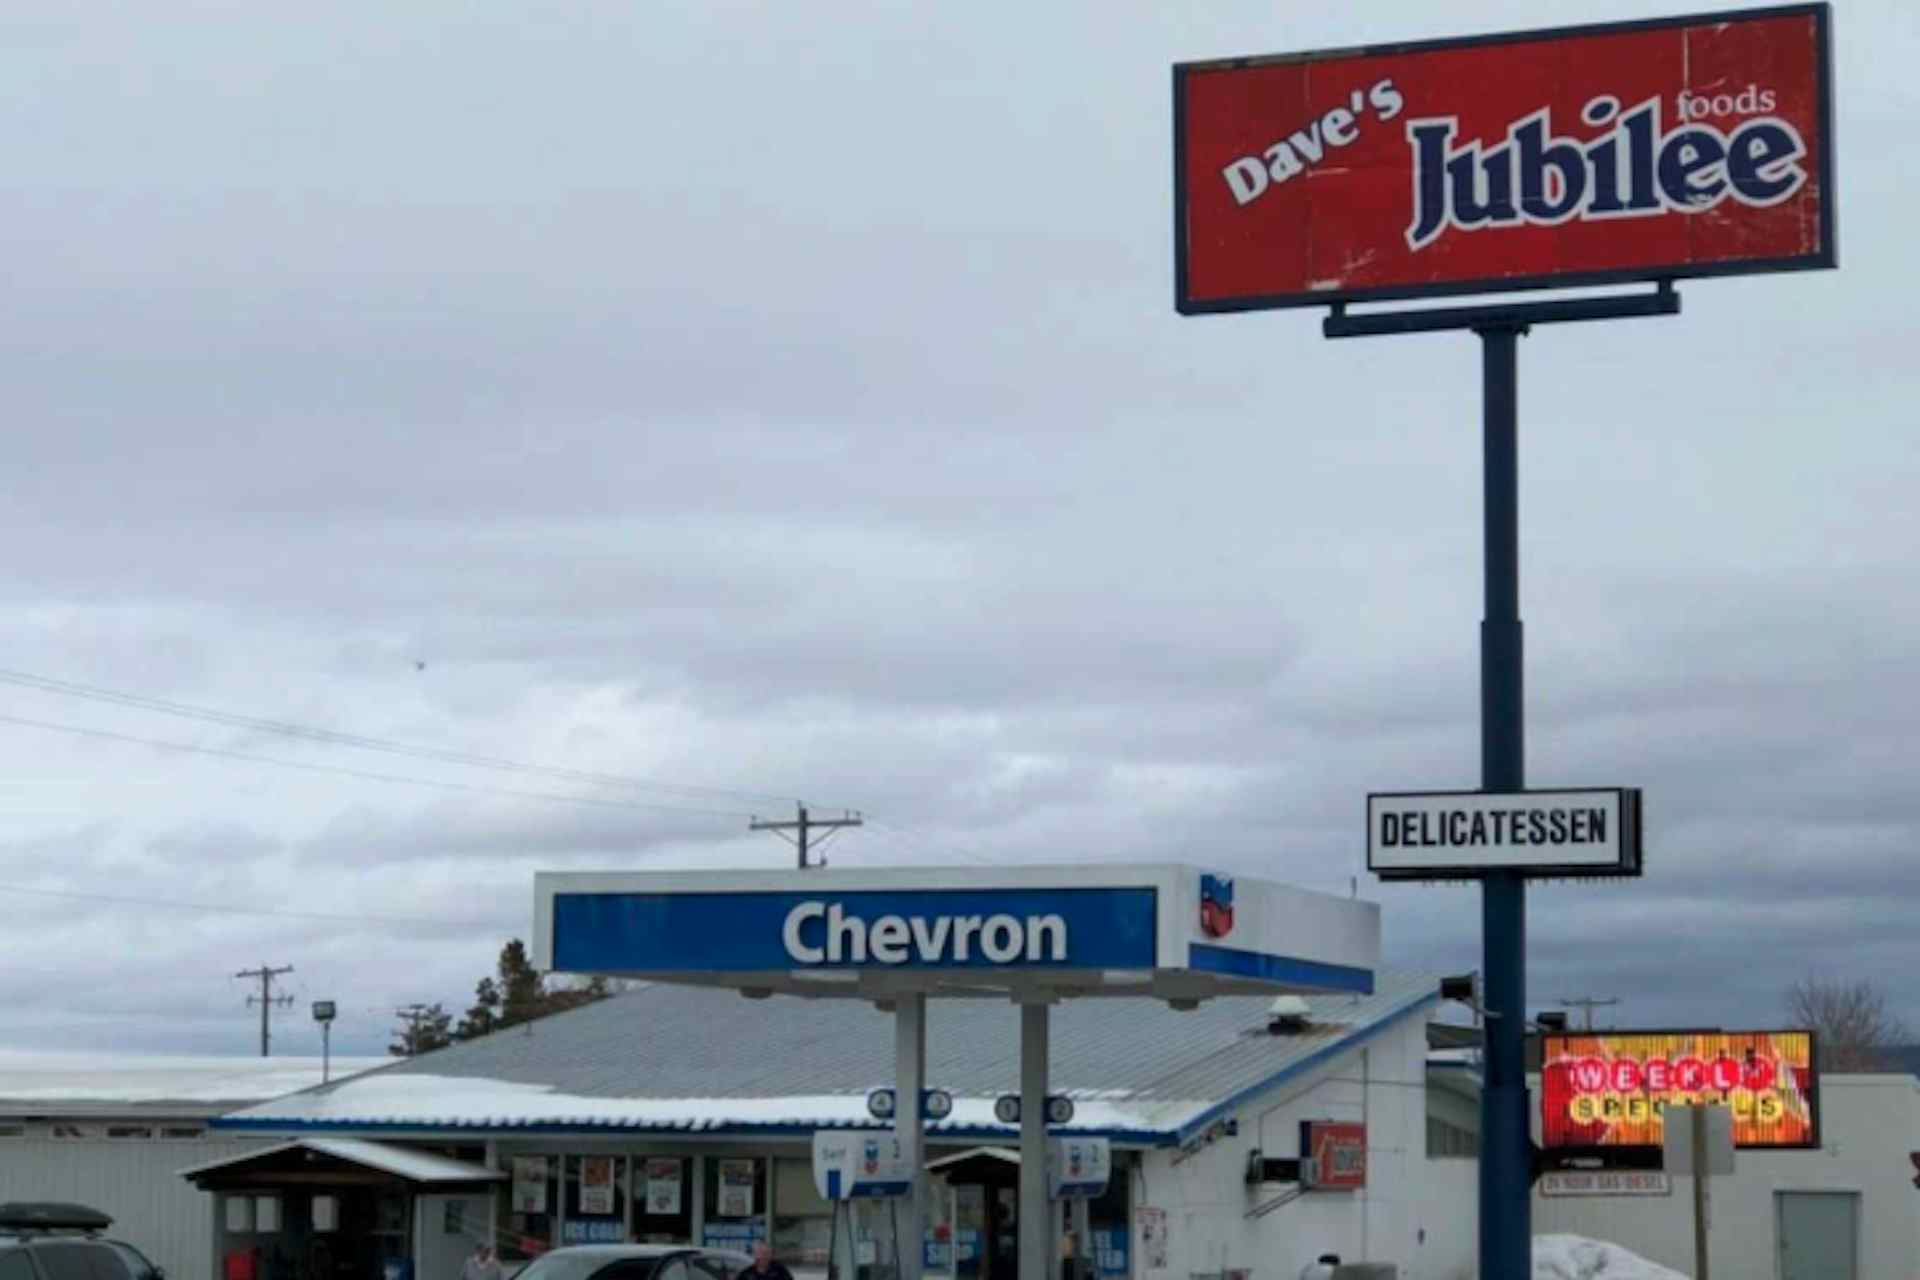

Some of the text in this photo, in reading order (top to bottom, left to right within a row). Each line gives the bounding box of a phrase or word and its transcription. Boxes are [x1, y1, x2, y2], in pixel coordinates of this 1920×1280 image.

[1677, 84, 1776, 119] foods
[1223, 77, 1403, 205] Dave's
[1405, 96, 1807, 251] Jubilee
[1381, 808, 1606, 847] DELICATESSEN
[782, 901, 1068, 964] Chevron
